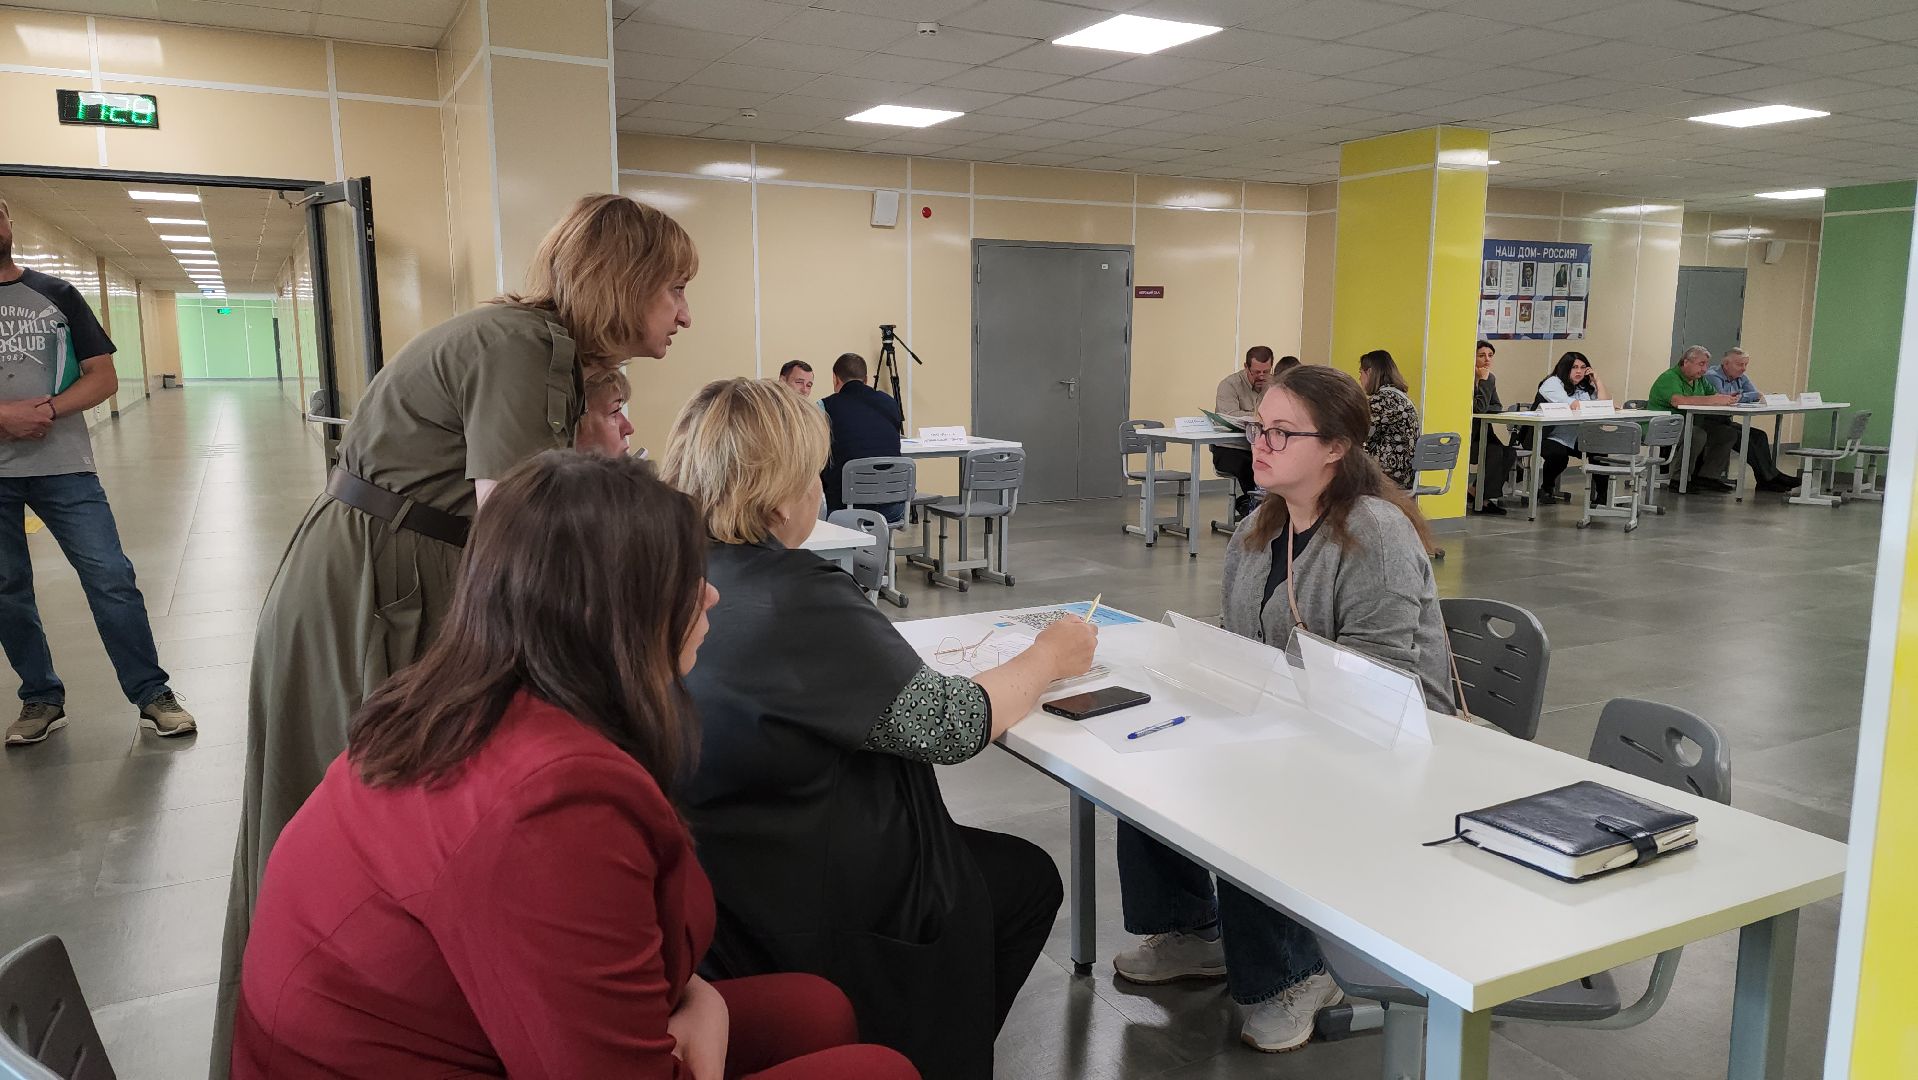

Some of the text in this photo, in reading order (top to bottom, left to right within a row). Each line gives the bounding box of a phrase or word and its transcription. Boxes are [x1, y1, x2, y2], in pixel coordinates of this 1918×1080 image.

[1495, 245, 1516, 257] НАШ
[1542, 247, 1578, 260] РОССИЯ!
[18, 319, 57, 335] HILLS
[8, 336, 46, 353] CLUB
[1, 353, 25, 362] 1982
